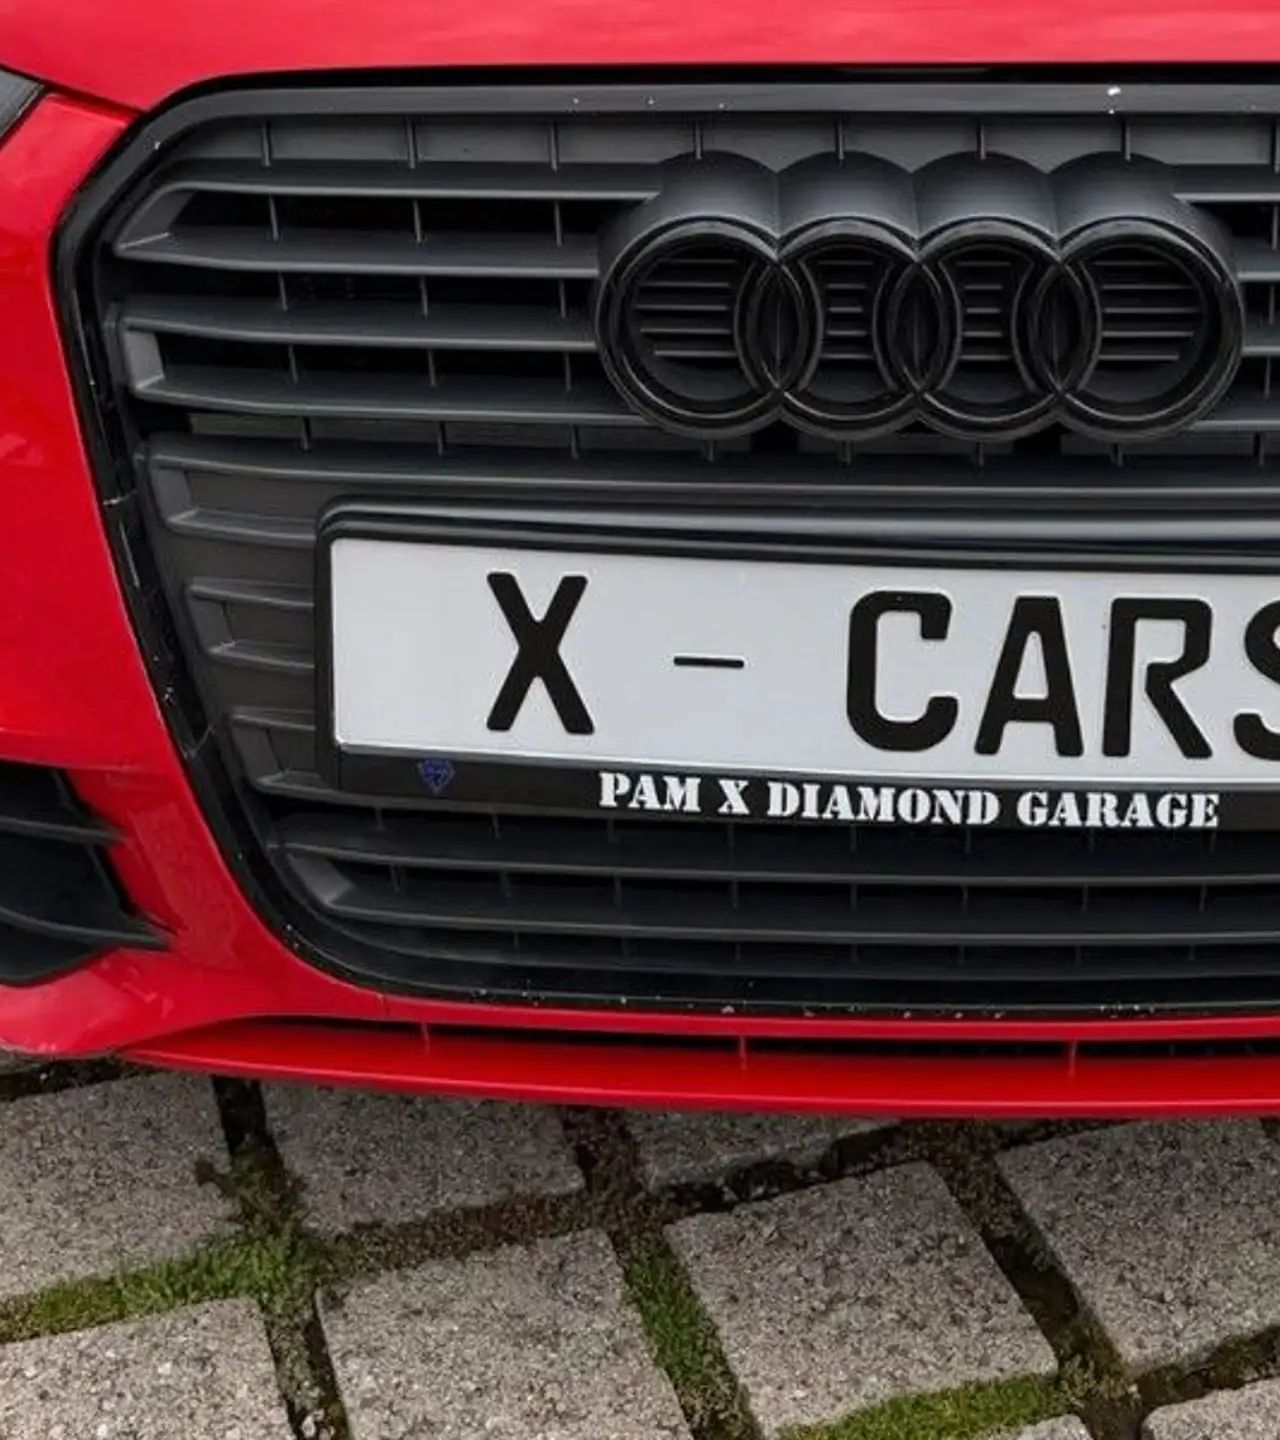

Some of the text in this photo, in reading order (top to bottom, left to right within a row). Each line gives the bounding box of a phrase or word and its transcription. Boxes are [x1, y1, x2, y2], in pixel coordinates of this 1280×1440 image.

[486, 571, 596, 735] X
[599, 770, 1221, 829] PAM X DIAMOND GARAGE
